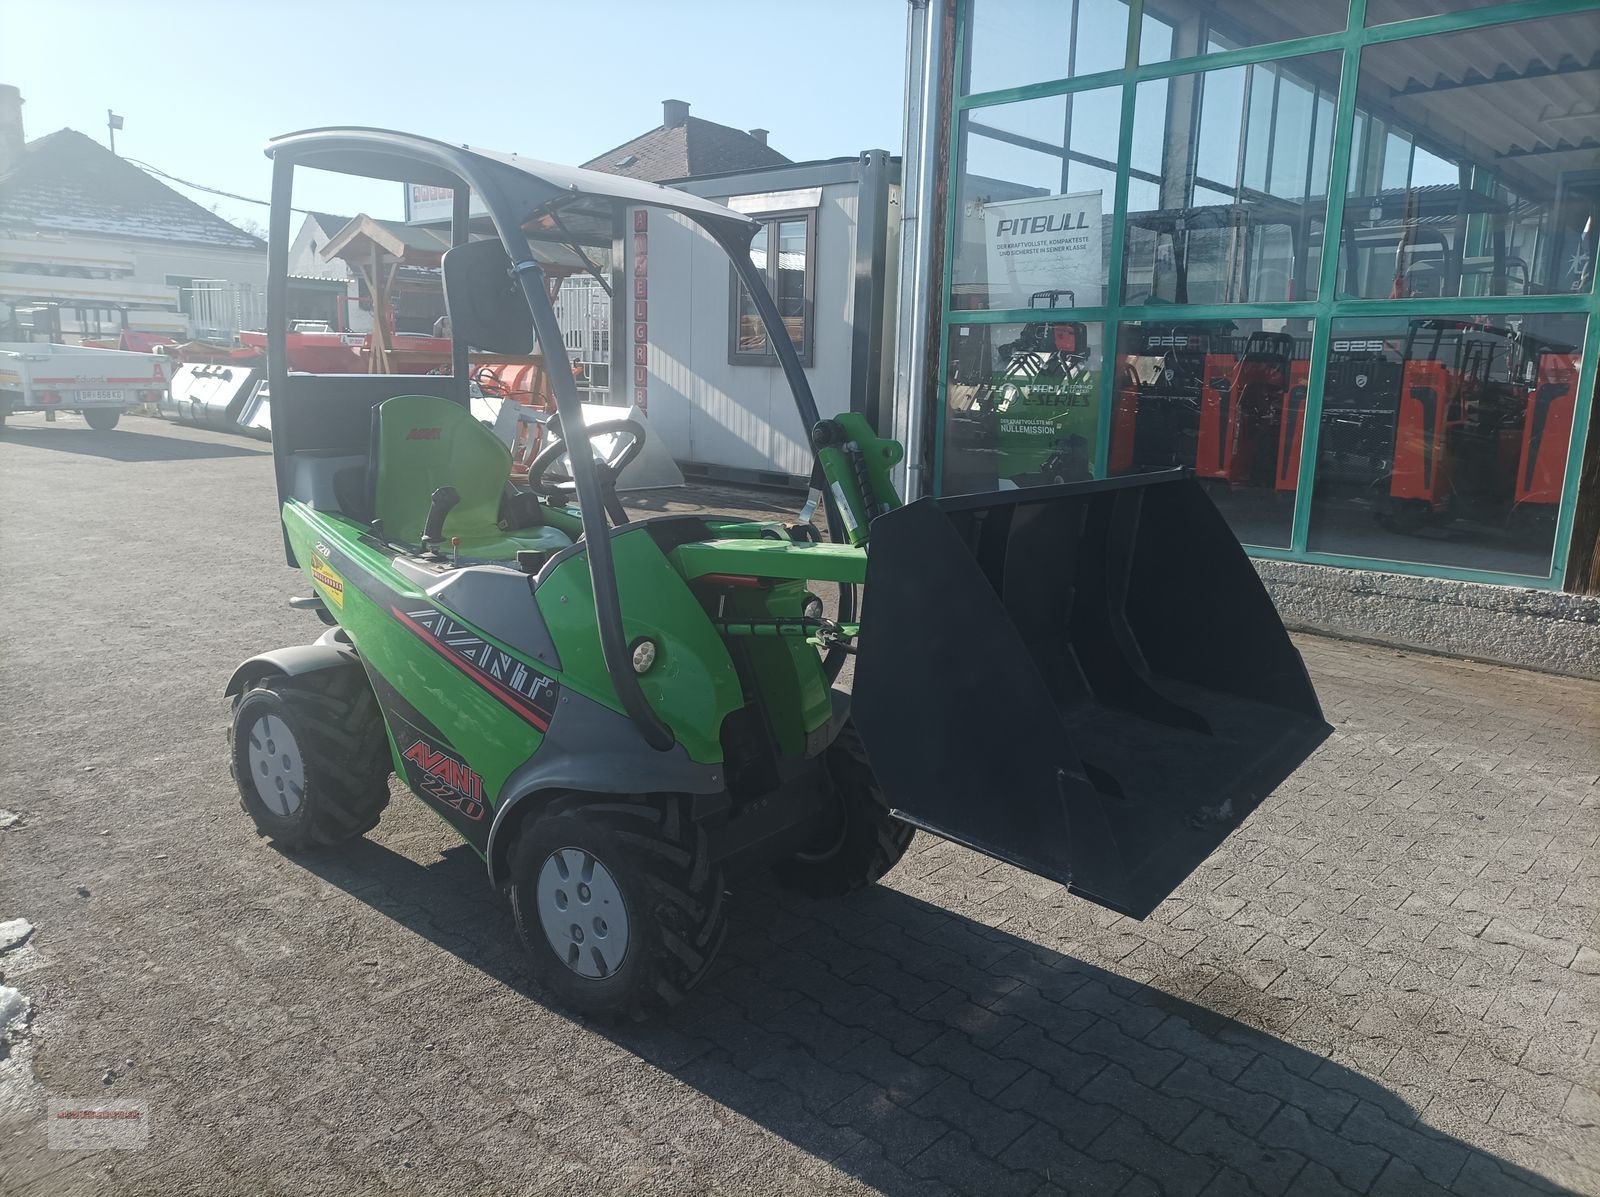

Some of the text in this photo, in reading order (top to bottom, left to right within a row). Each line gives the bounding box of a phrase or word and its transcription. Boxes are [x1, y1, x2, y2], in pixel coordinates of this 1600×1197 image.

[996, 211, 1090, 237] PITBULL
[1046, 245, 1066, 253] SEINER
[1066, 243, 1087, 251] KLASSE
[1049, 236, 1089, 245] KOMPAKTESTE
[1000, 425, 1055, 435] NULLEMISSION
[315, 541, 331, 558] 220
[402, 739, 484, 801] AVANT
[419, 773, 486, 821] 220
